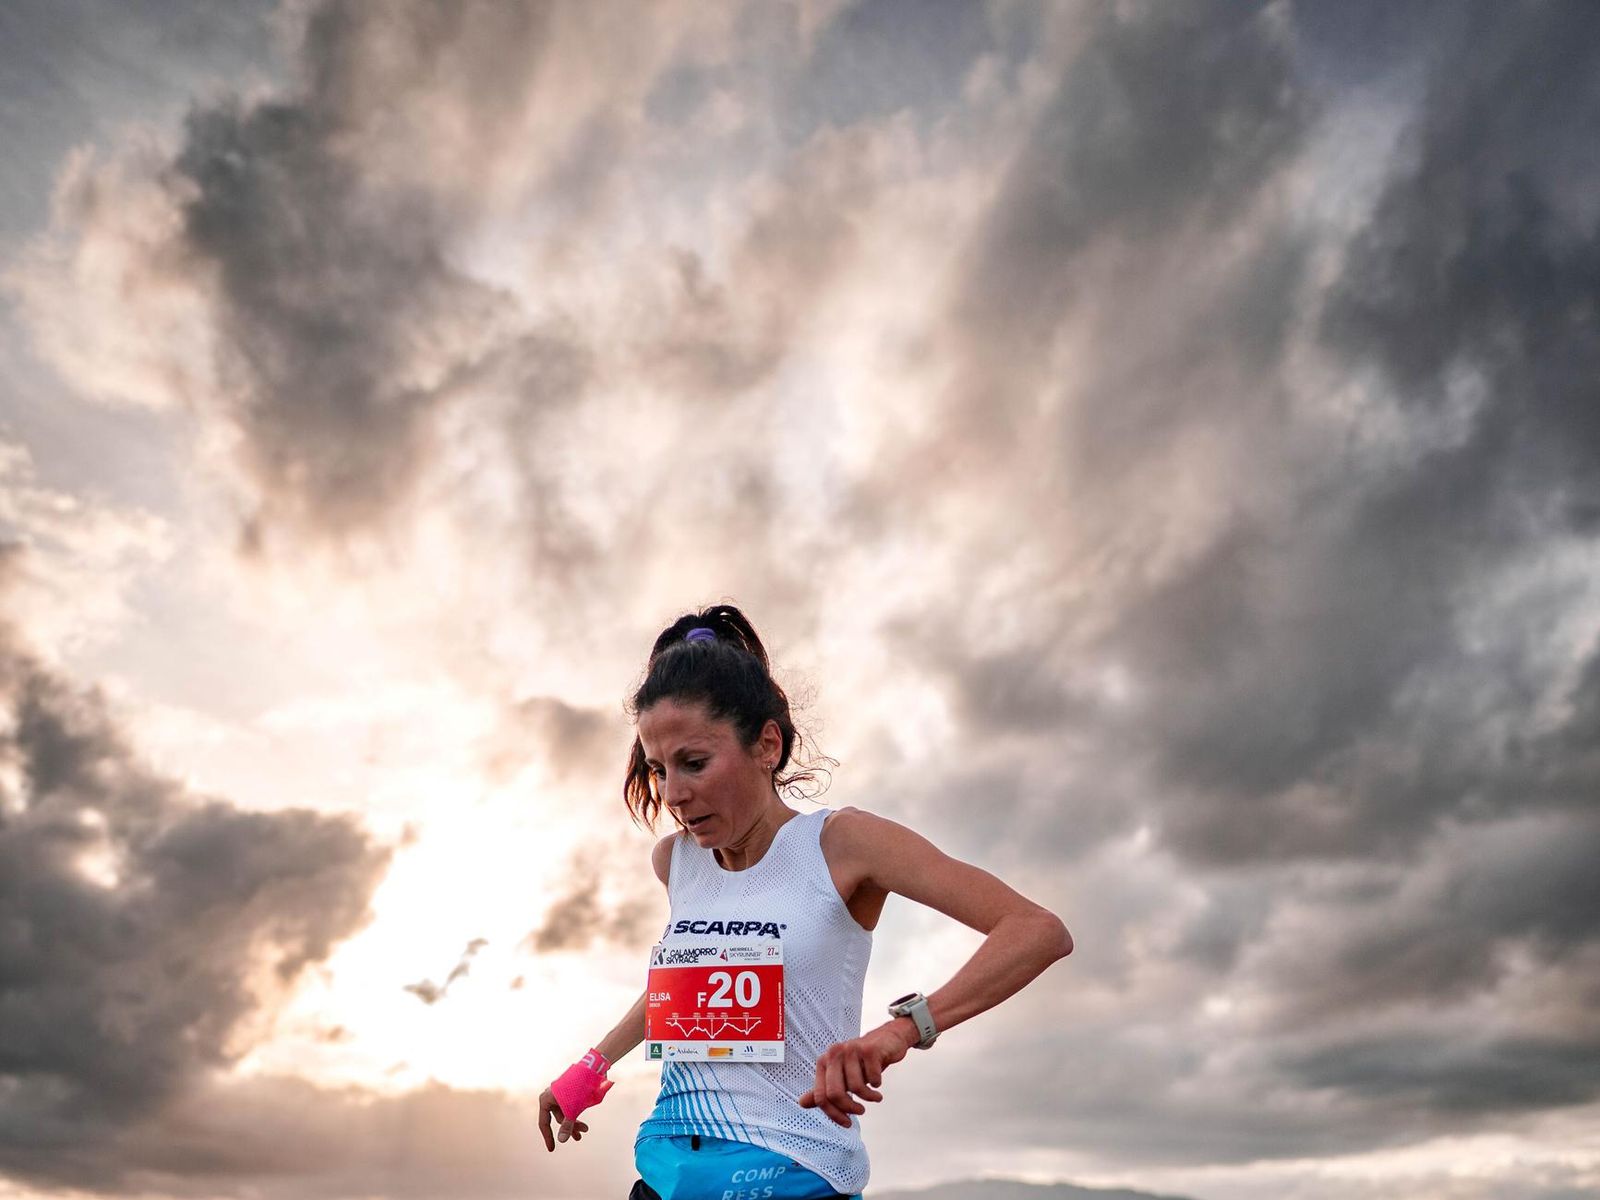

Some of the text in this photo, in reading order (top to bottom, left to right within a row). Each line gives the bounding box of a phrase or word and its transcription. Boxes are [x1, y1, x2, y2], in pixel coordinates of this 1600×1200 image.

[674, 920, 781, 939] SCARPA
[669, 947, 718, 958] CALAMORRO
[665, 955, 699, 965] SKYRACE
[649, 992, 671, 1002] ELISA
[731, 1166, 786, 1184] COMP
